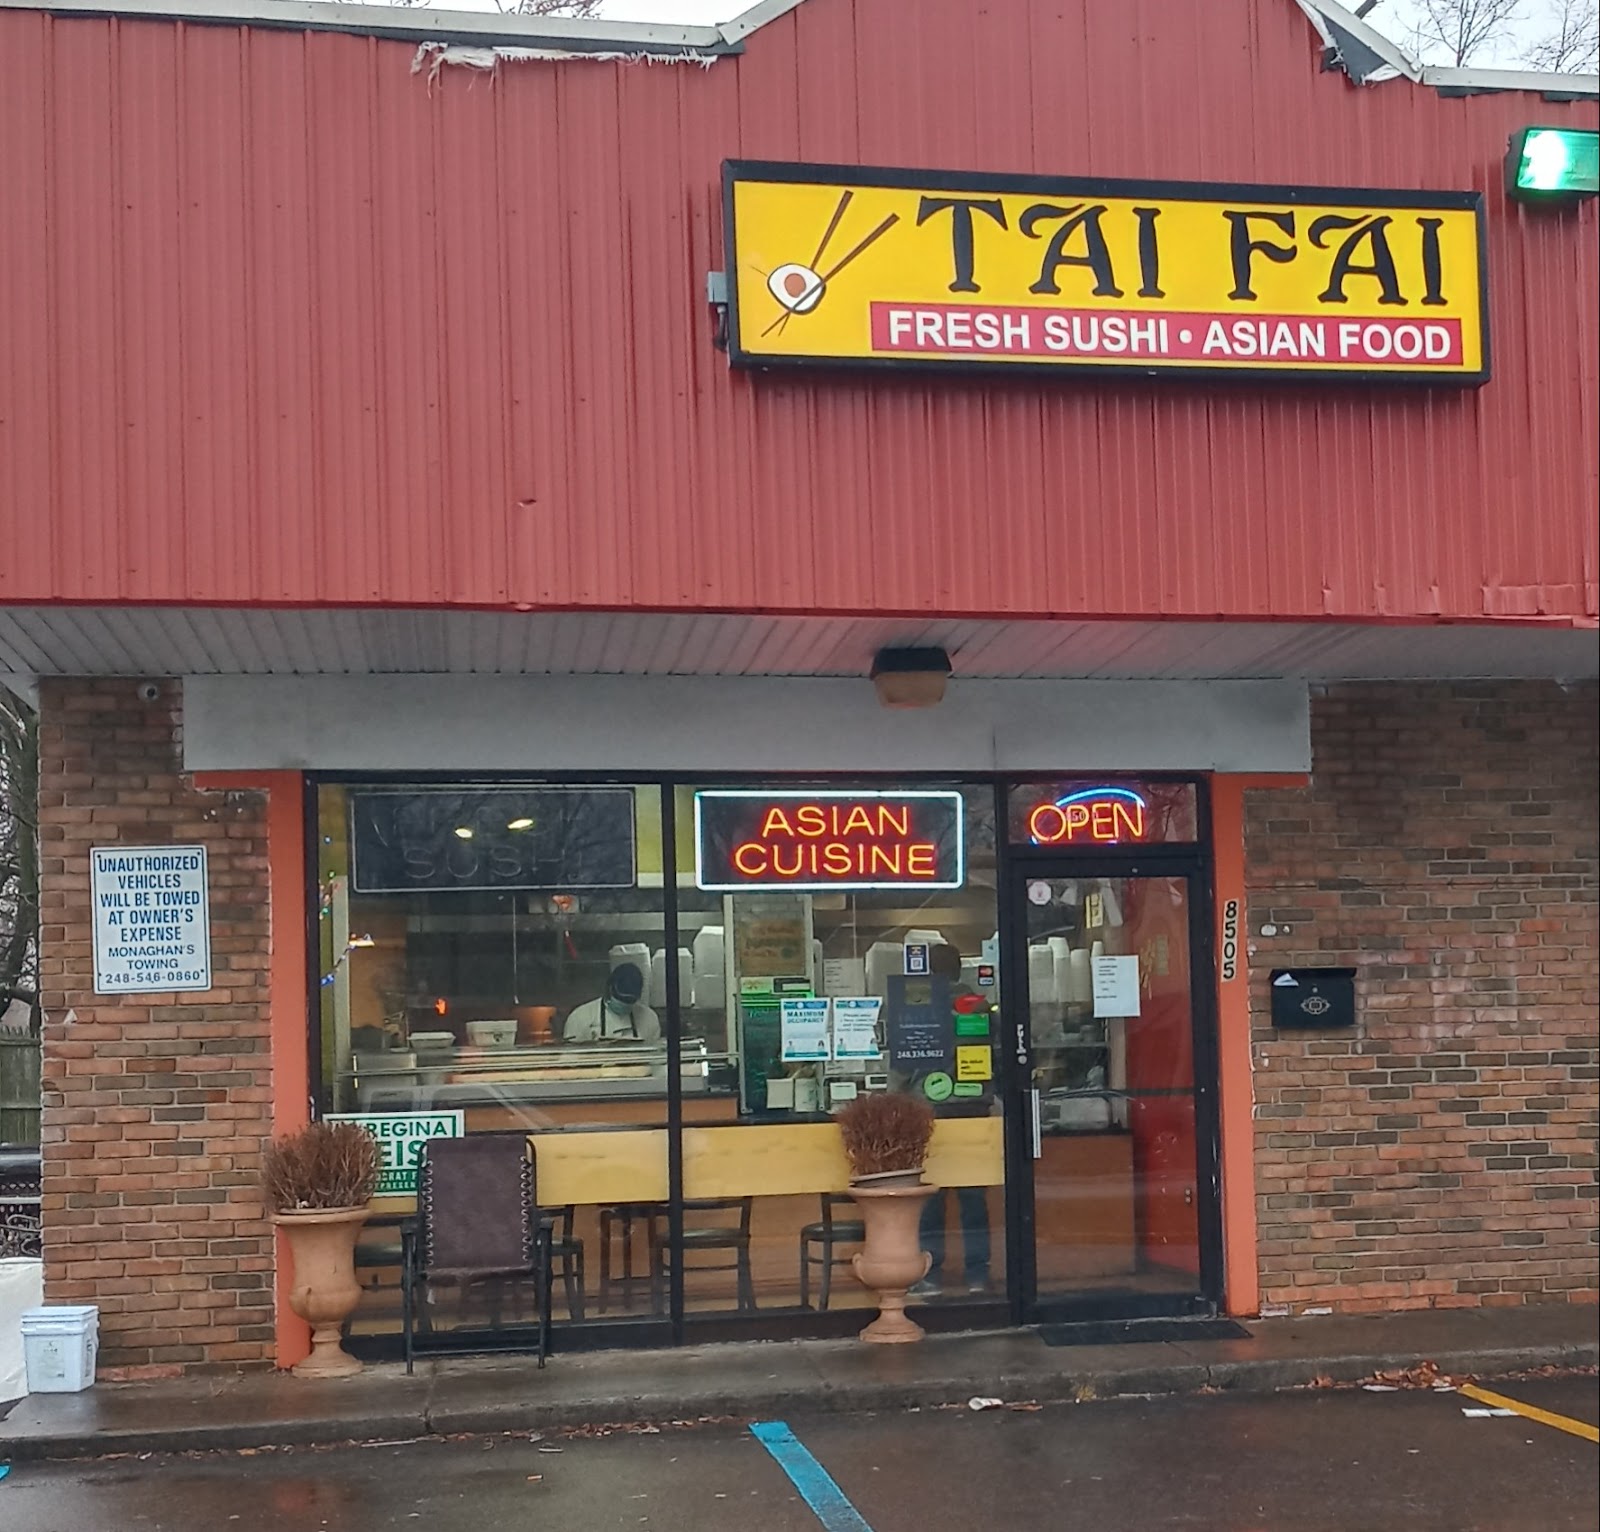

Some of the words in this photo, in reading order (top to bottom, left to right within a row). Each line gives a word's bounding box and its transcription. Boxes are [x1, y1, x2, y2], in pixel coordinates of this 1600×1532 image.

[917, 195, 1166, 299] TAI
[1222, 210, 1448, 306] FAI
[889, 309, 1031, 349] FRESH
[1044, 314, 1169, 353] SUSHI
[1202, 320, 1325, 357] ASIAN
[1339, 323, 1451, 360] FOOD
[762, 804, 909, 838] ASIAN
[1030, 800, 1143, 841] OPEN
[99, 855, 199, 872] UNAUTHORIZED
[734, 842, 936, 876] CUISINE
[118, 874, 182, 889] VEHICLES
[100, 893, 130, 907] WILL
[135, 892, 150, 906] BE
[154, 891, 200, 905] TOWED
[108, 910, 124, 925] AT
[130, 908, 193, 924] OWNER'S
[121, 926, 182, 942] EXPENSE
[1222, 900, 1238, 980] 8505
[108, 944, 195, 957] MONAGHAN'S
[126, 958, 179, 970] TOWING
[105, 970, 200, 984] 248-546-0860
[366, 1121, 448, 1138] REGINA
